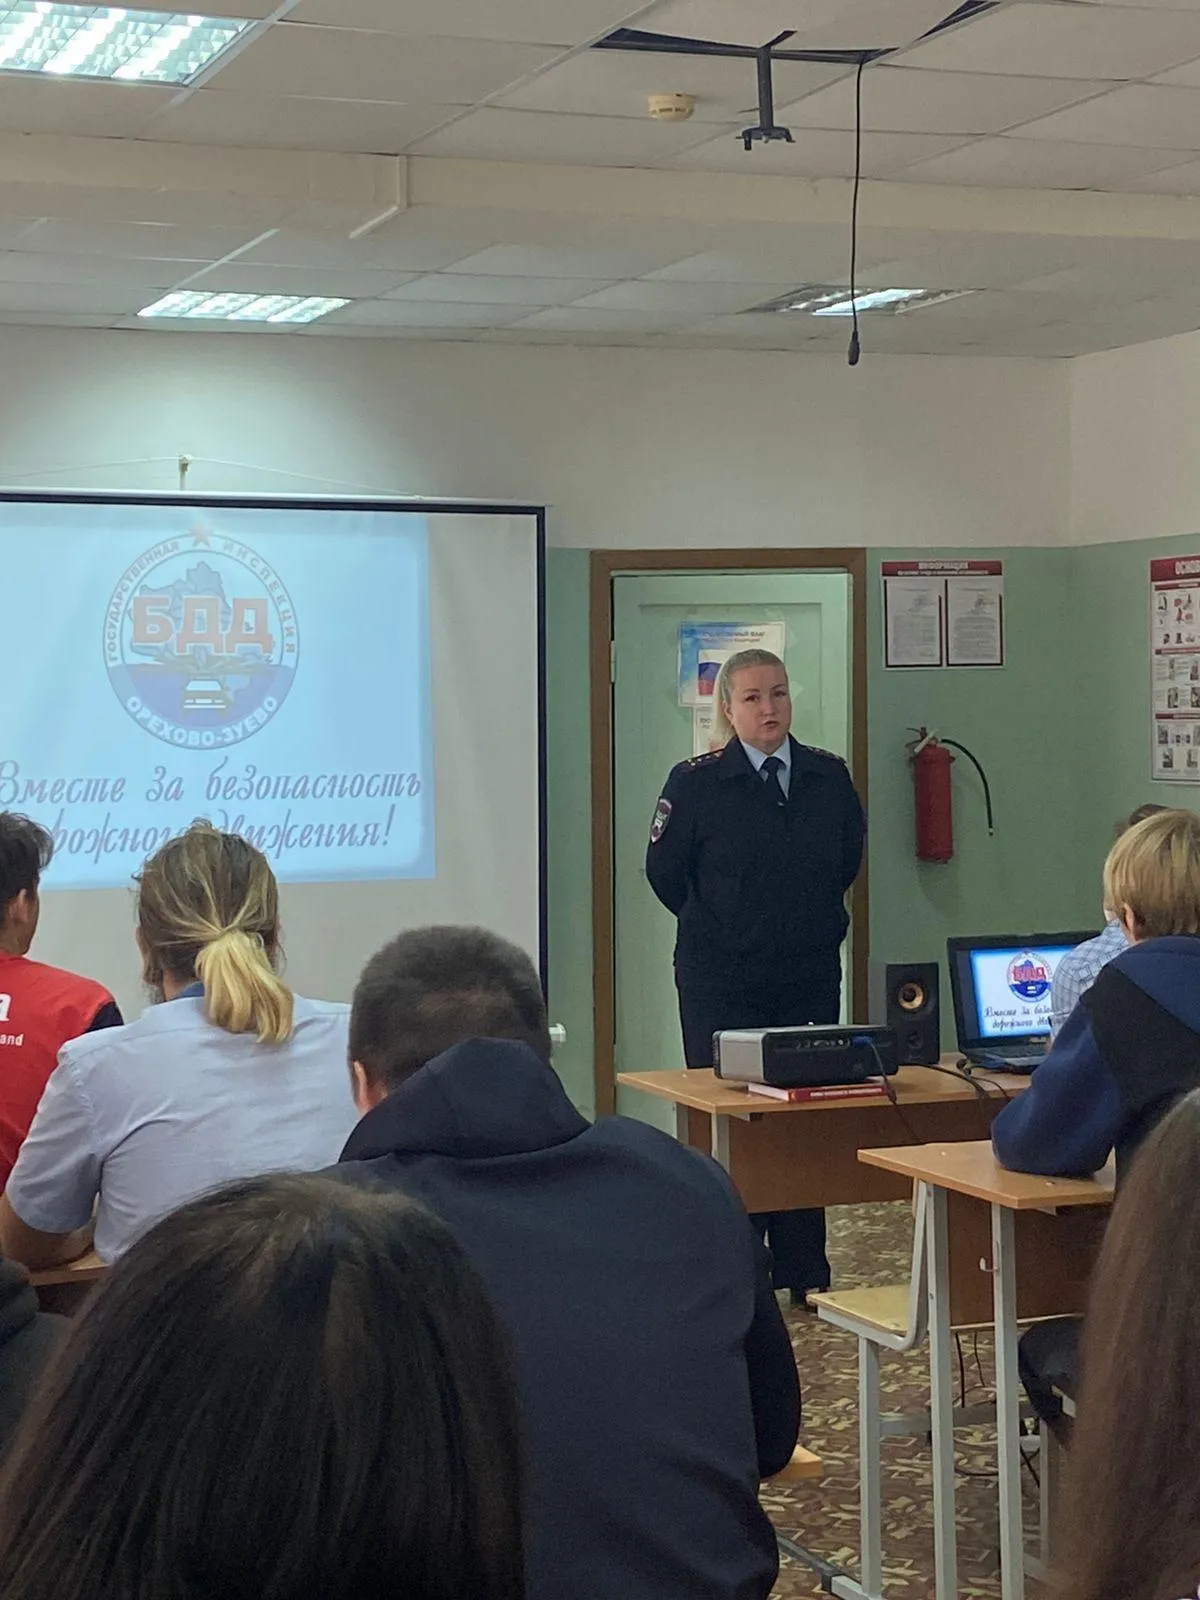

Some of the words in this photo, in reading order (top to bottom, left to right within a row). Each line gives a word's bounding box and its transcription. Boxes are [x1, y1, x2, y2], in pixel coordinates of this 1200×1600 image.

[106, 540, 180, 663] ГОСУДАРСТВЕННАЯ
[218, 540, 295, 654] ИНСПЕКЦИЯ
[131, 596, 274, 655] БДД
[125, 696, 279, 747] ОРЕХОВО-ЗУЕВО
[0, 760, 126, 805] Вместе
